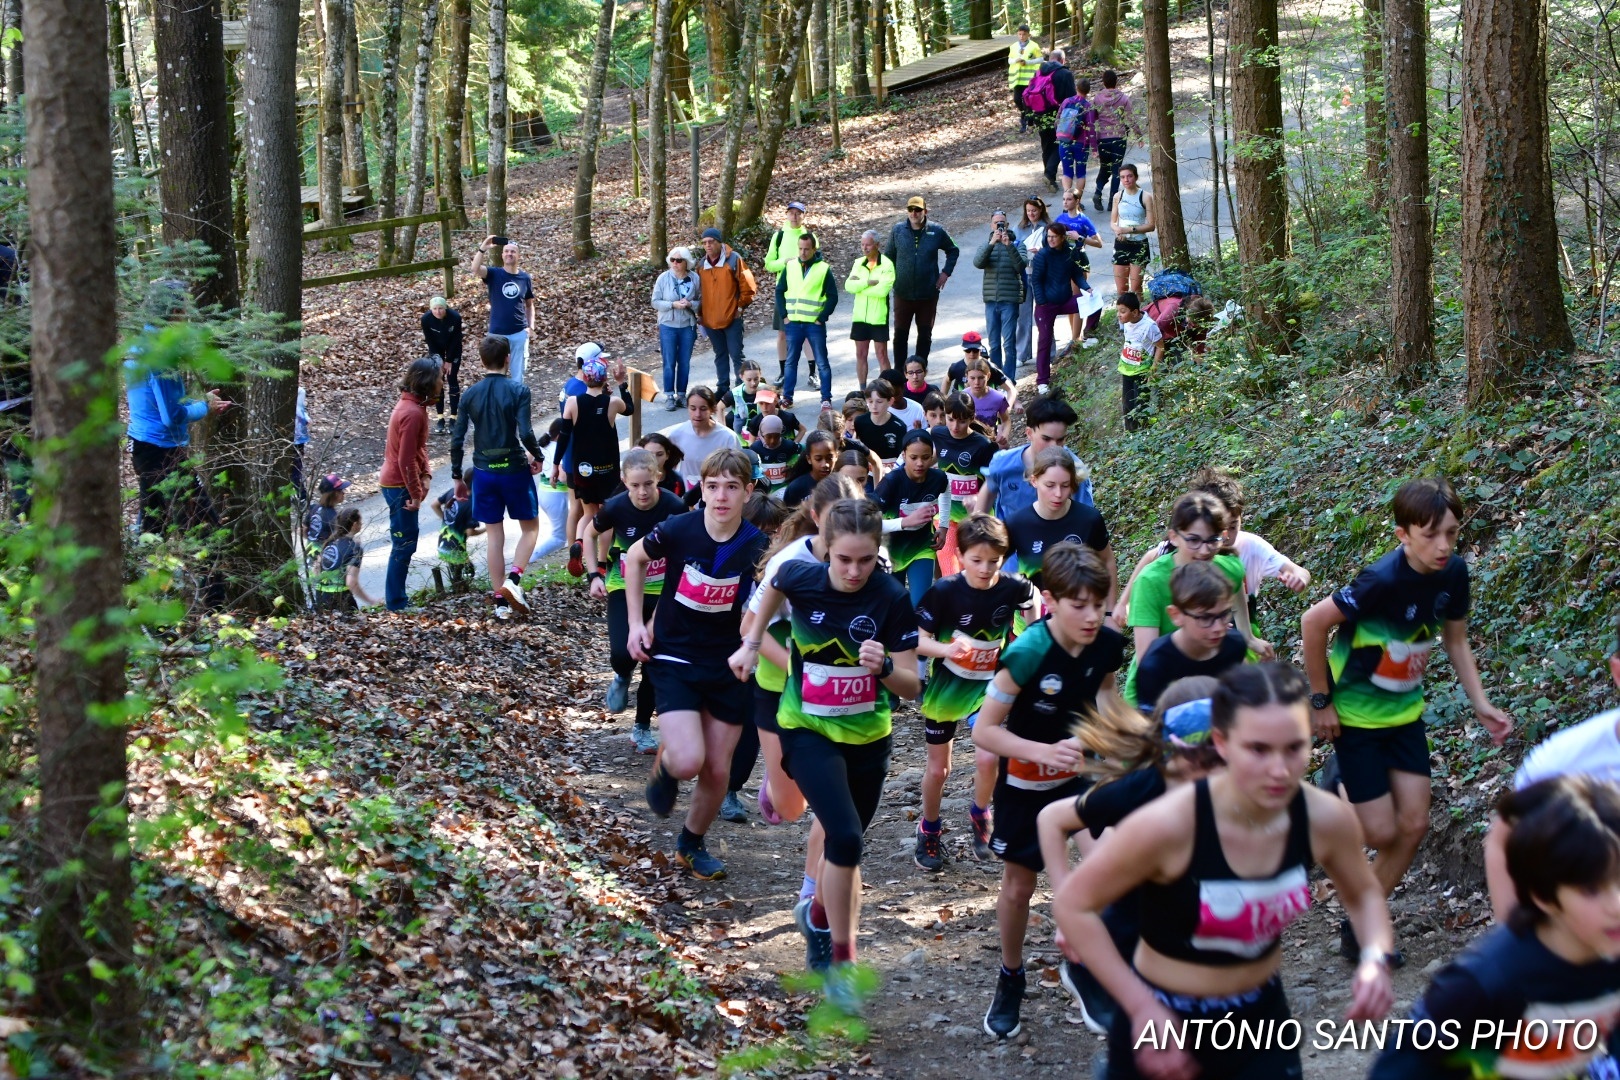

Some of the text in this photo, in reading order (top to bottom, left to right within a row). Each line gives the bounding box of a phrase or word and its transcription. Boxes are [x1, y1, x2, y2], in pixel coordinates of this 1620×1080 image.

[954, 480, 977, 491] 1715
[646, 557, 666, 571] 702
[703, 585, 735, 598] 1716
[832, 676, 871, 696] 1701
